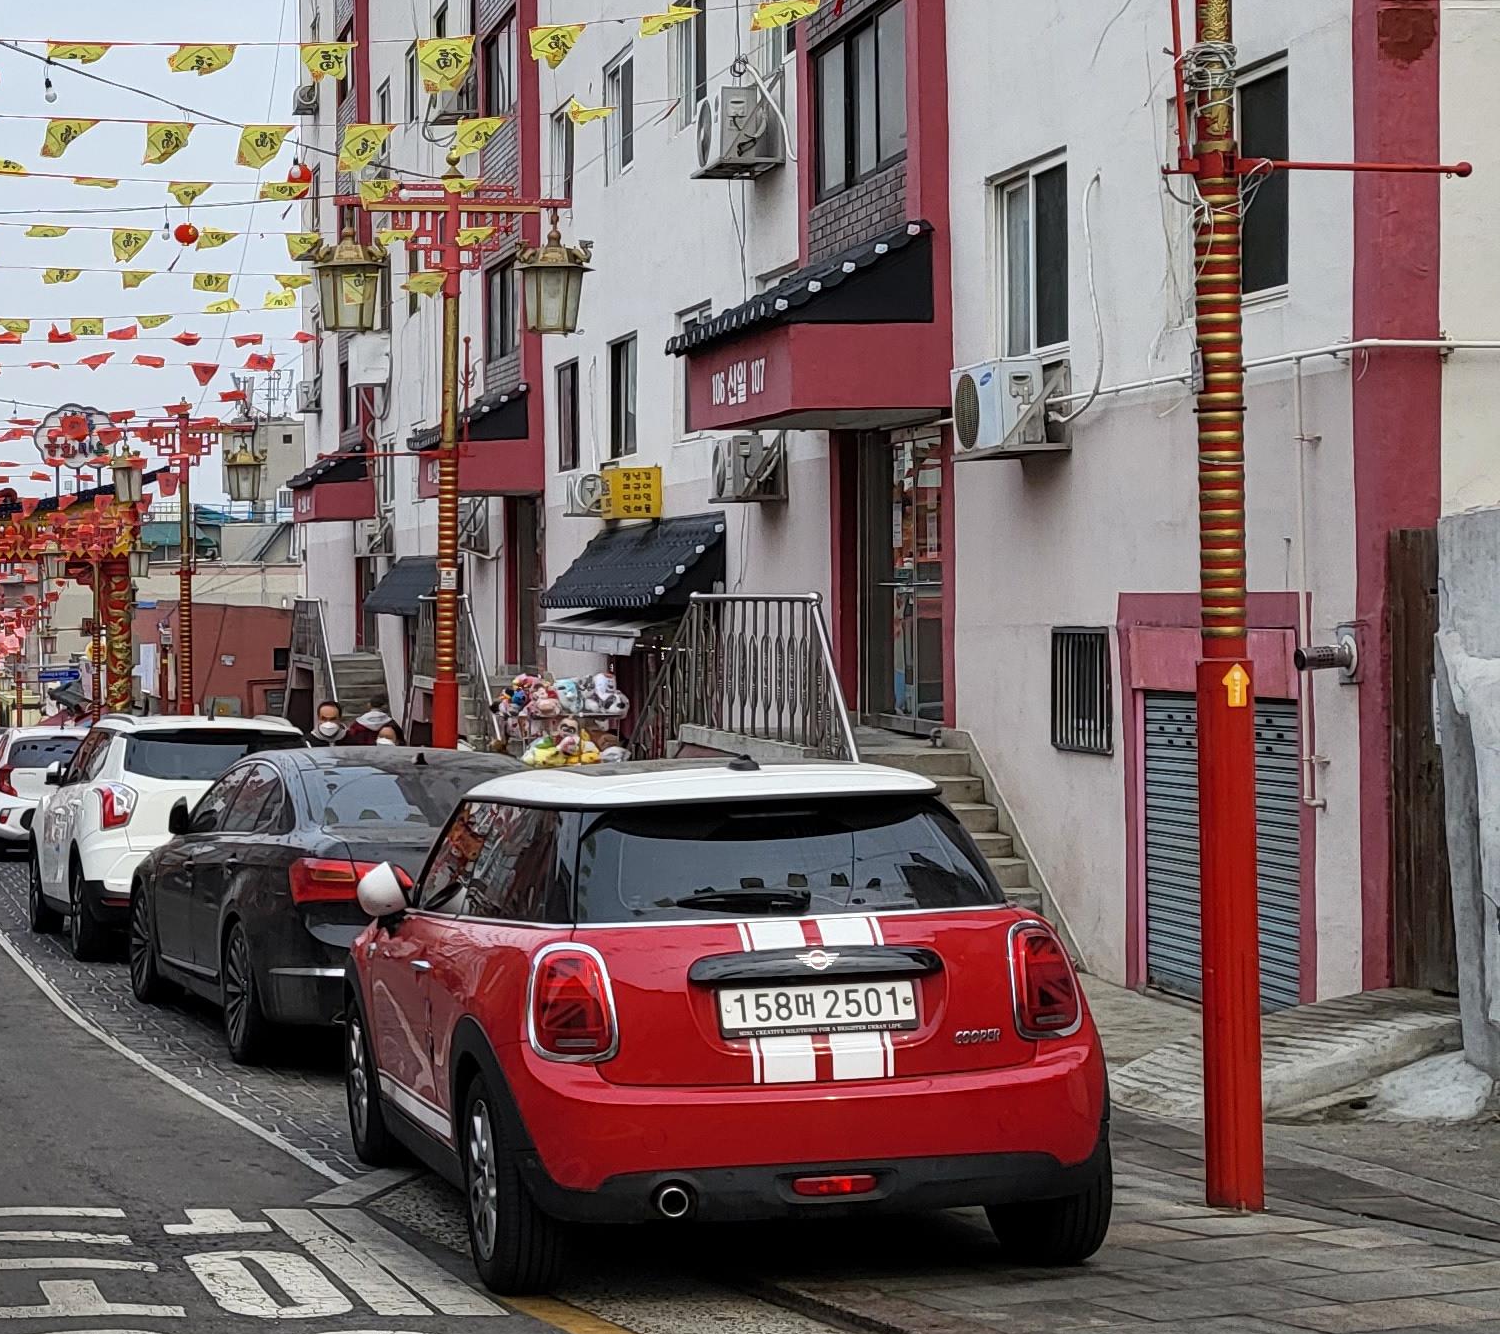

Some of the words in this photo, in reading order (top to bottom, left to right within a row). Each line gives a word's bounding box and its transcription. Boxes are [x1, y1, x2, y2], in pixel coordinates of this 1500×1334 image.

[751, 357, 765, 395] 107
[823, 986, 901, 1019] 2501
[954, 1028, 1001, 1044] COOPER
